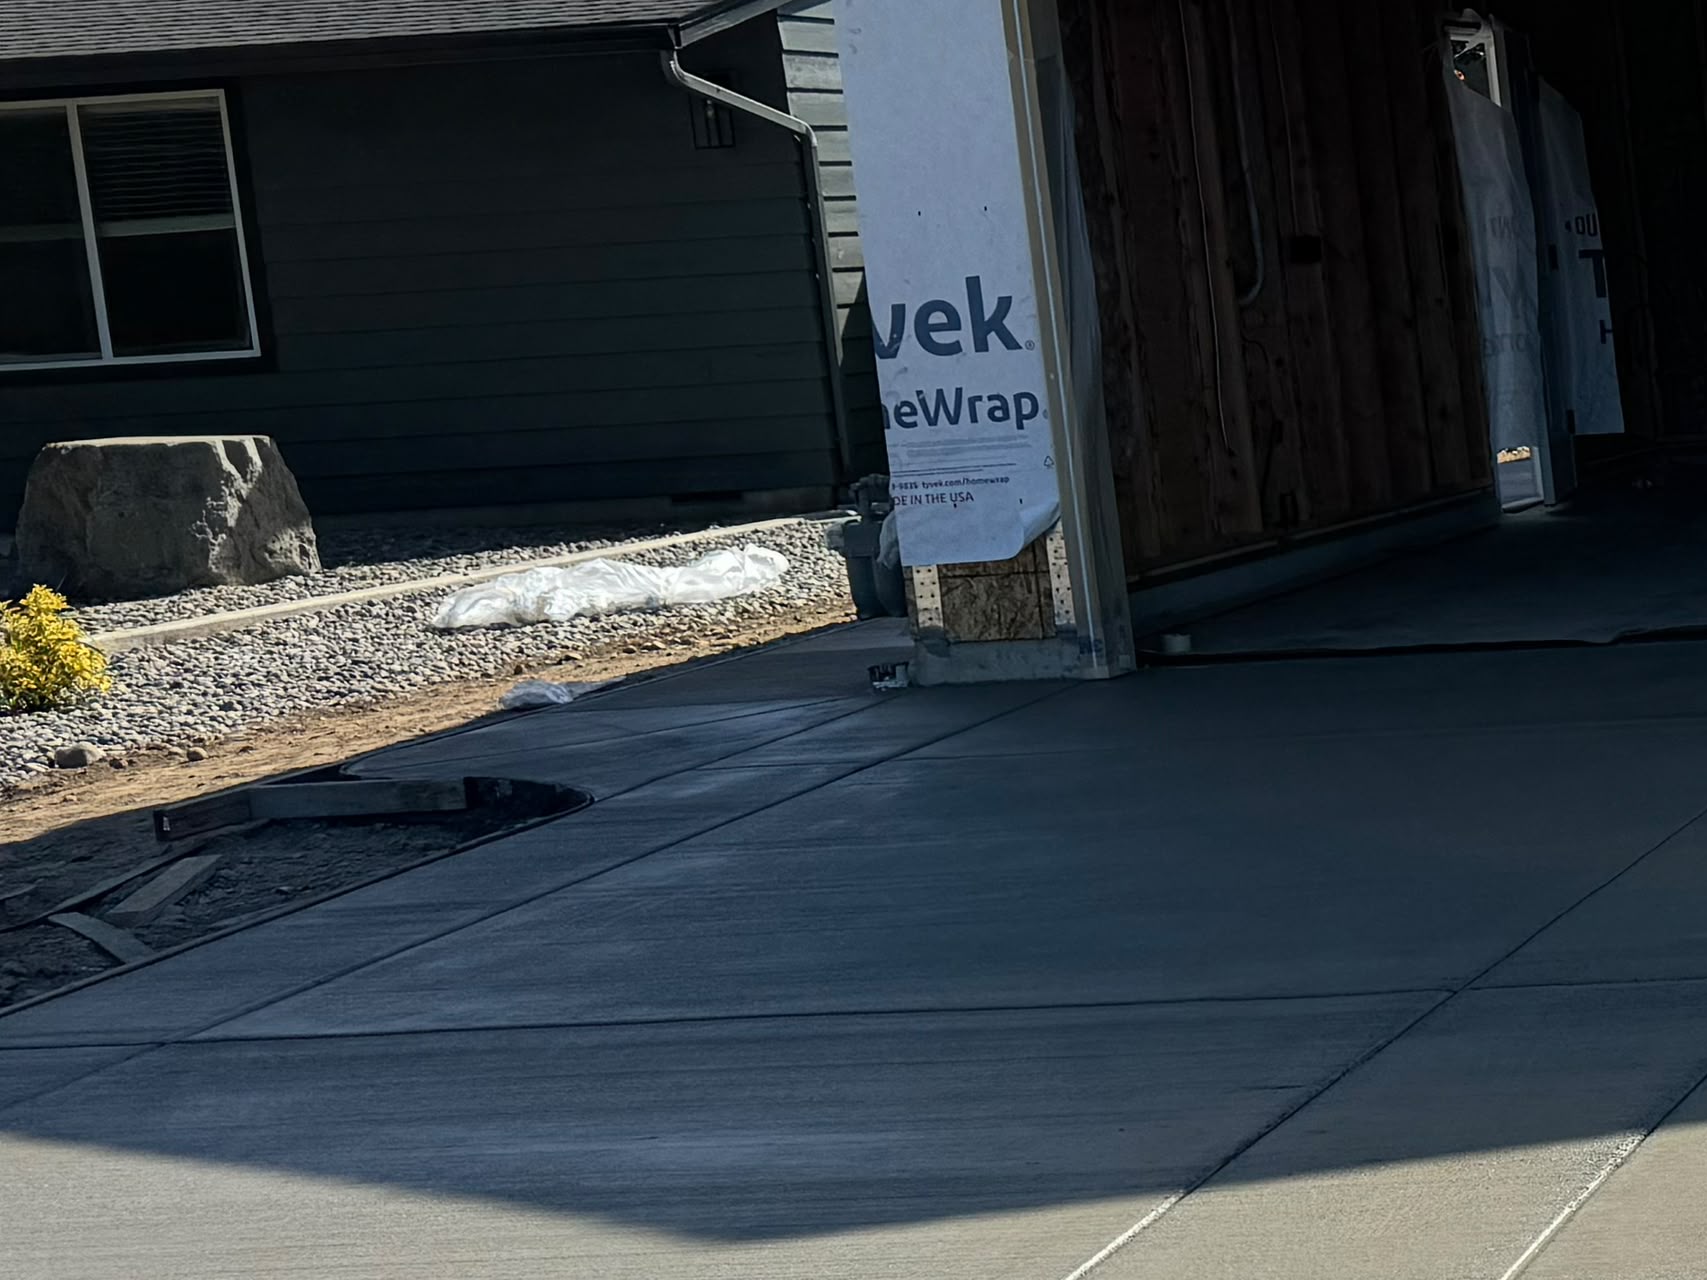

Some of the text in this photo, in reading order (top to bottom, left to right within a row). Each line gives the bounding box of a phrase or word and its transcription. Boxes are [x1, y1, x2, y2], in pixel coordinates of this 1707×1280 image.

[882, 387, 1040, 430] eWrap
[922, 476, 1010, 490] tyvek.com/homewrap
[911, 494, 923, 506] IN
[925, 493, 947, 505] THE
[950, 492, 975, 503] USA
